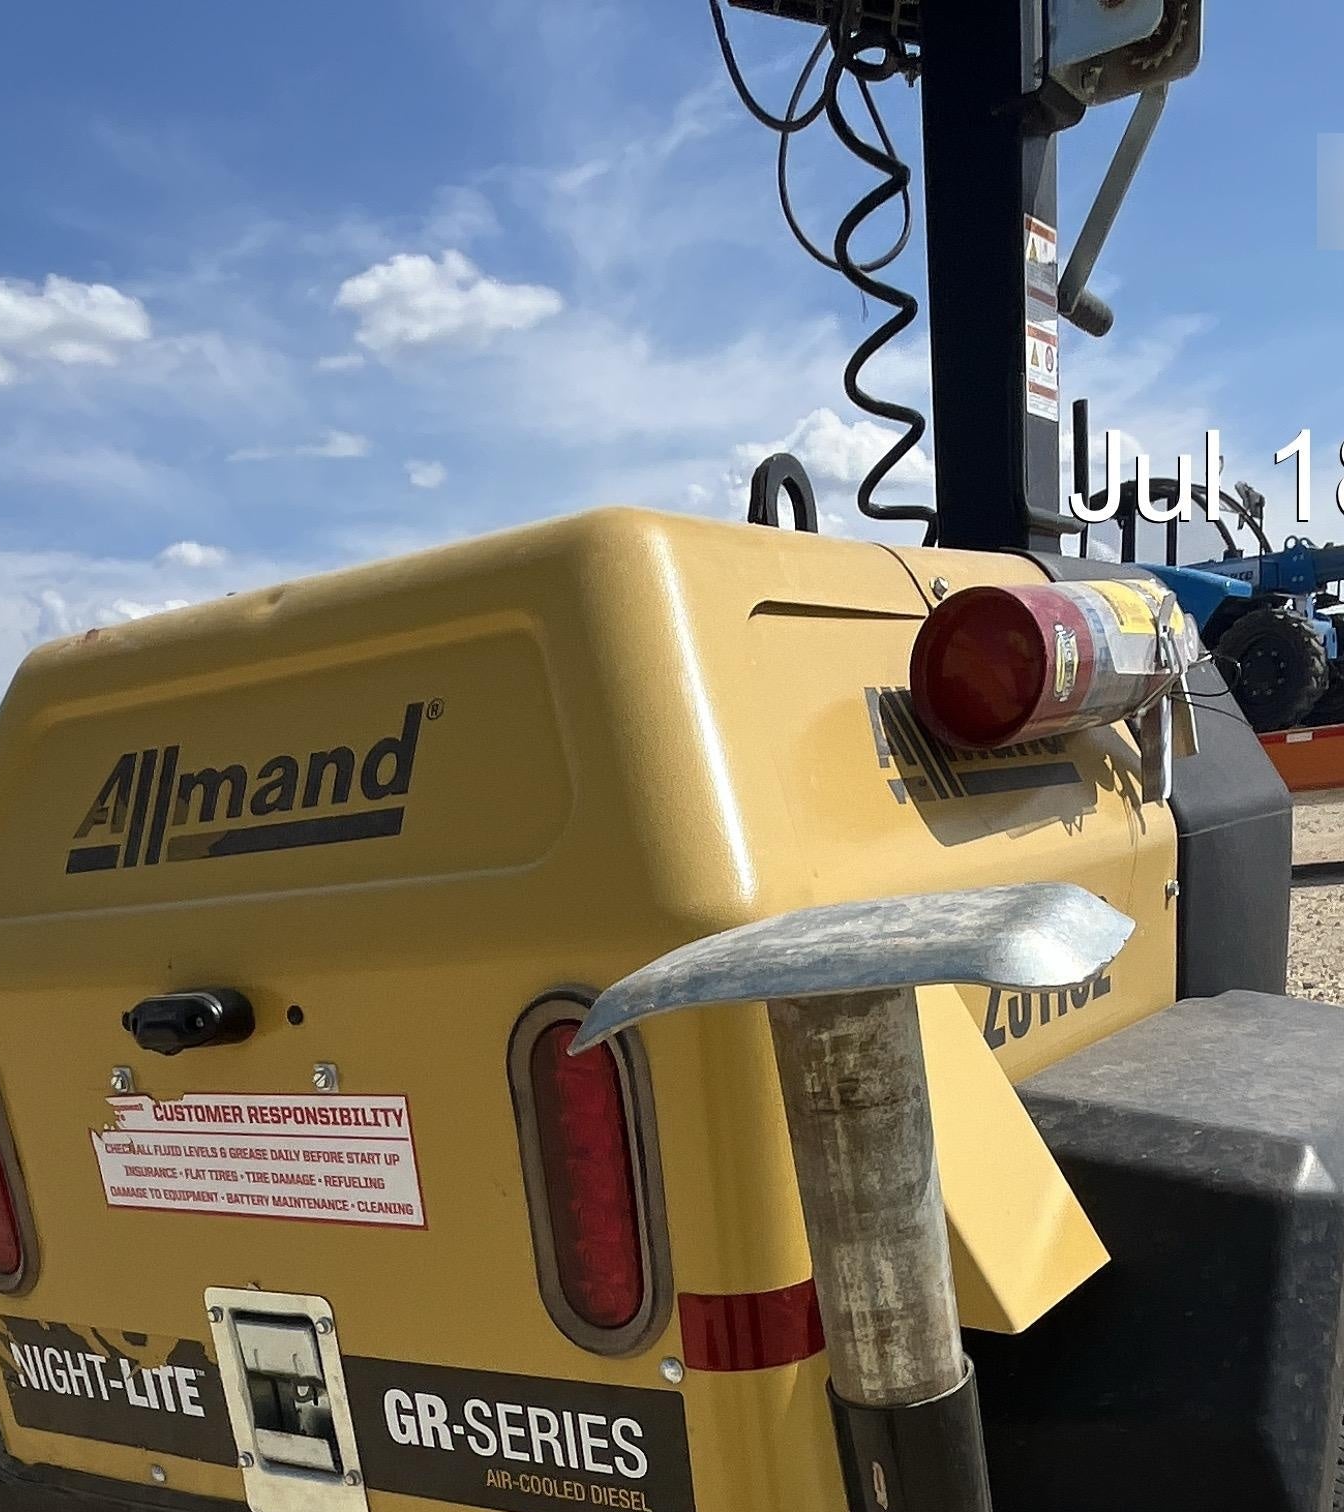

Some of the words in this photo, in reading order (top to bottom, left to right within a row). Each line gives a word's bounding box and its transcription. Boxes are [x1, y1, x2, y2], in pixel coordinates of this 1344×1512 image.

[152, 1103, 245, 1124] CUSTOMER
[246, 1105, 403, 1128] RESPONSIBILITY
[138, 1144, 154, 1157] ALL
[155, 1144, 182, 1158] FLUID
[183, 1145, 218, 1159] LEVELS
[229, 1148, 268, 1161] GREASE
[270, 1150, 301, 1163] DAILY
[303, 1151, 345, 1164] BEFORE
[346, 1153, 382, 1166] START
[384, 1154, 400, 1167] UP
[124, 1165, 177, 1179] INSURANCE
[184, 1168, 206, 1181] FLAT
[207, 1170, 238, 1183] TIRES
[245, 1171, 270, 1184] TIRE
[271, 1172, 317, 1186] DAMAGE
[324, 1175, 386, 1190] REFUELING
[109, 1186, 148, 1199] DAMAGE
[149, 1188, 162, 1200] TO
[163, 1189, 218, 1203] EQUIPMENT
[226, 1192, 269, 1207] BATTERY
[272, 1195, 350, 1211] MAINTENANCE
[357, 1200, 414, 1216] CLEANING
[383, 1388, 648, 1480] GR-SERIES
[486, 1468, 586, 1502] AIR-COOLED
[589, 1483, 653, 1512] DIESEL
